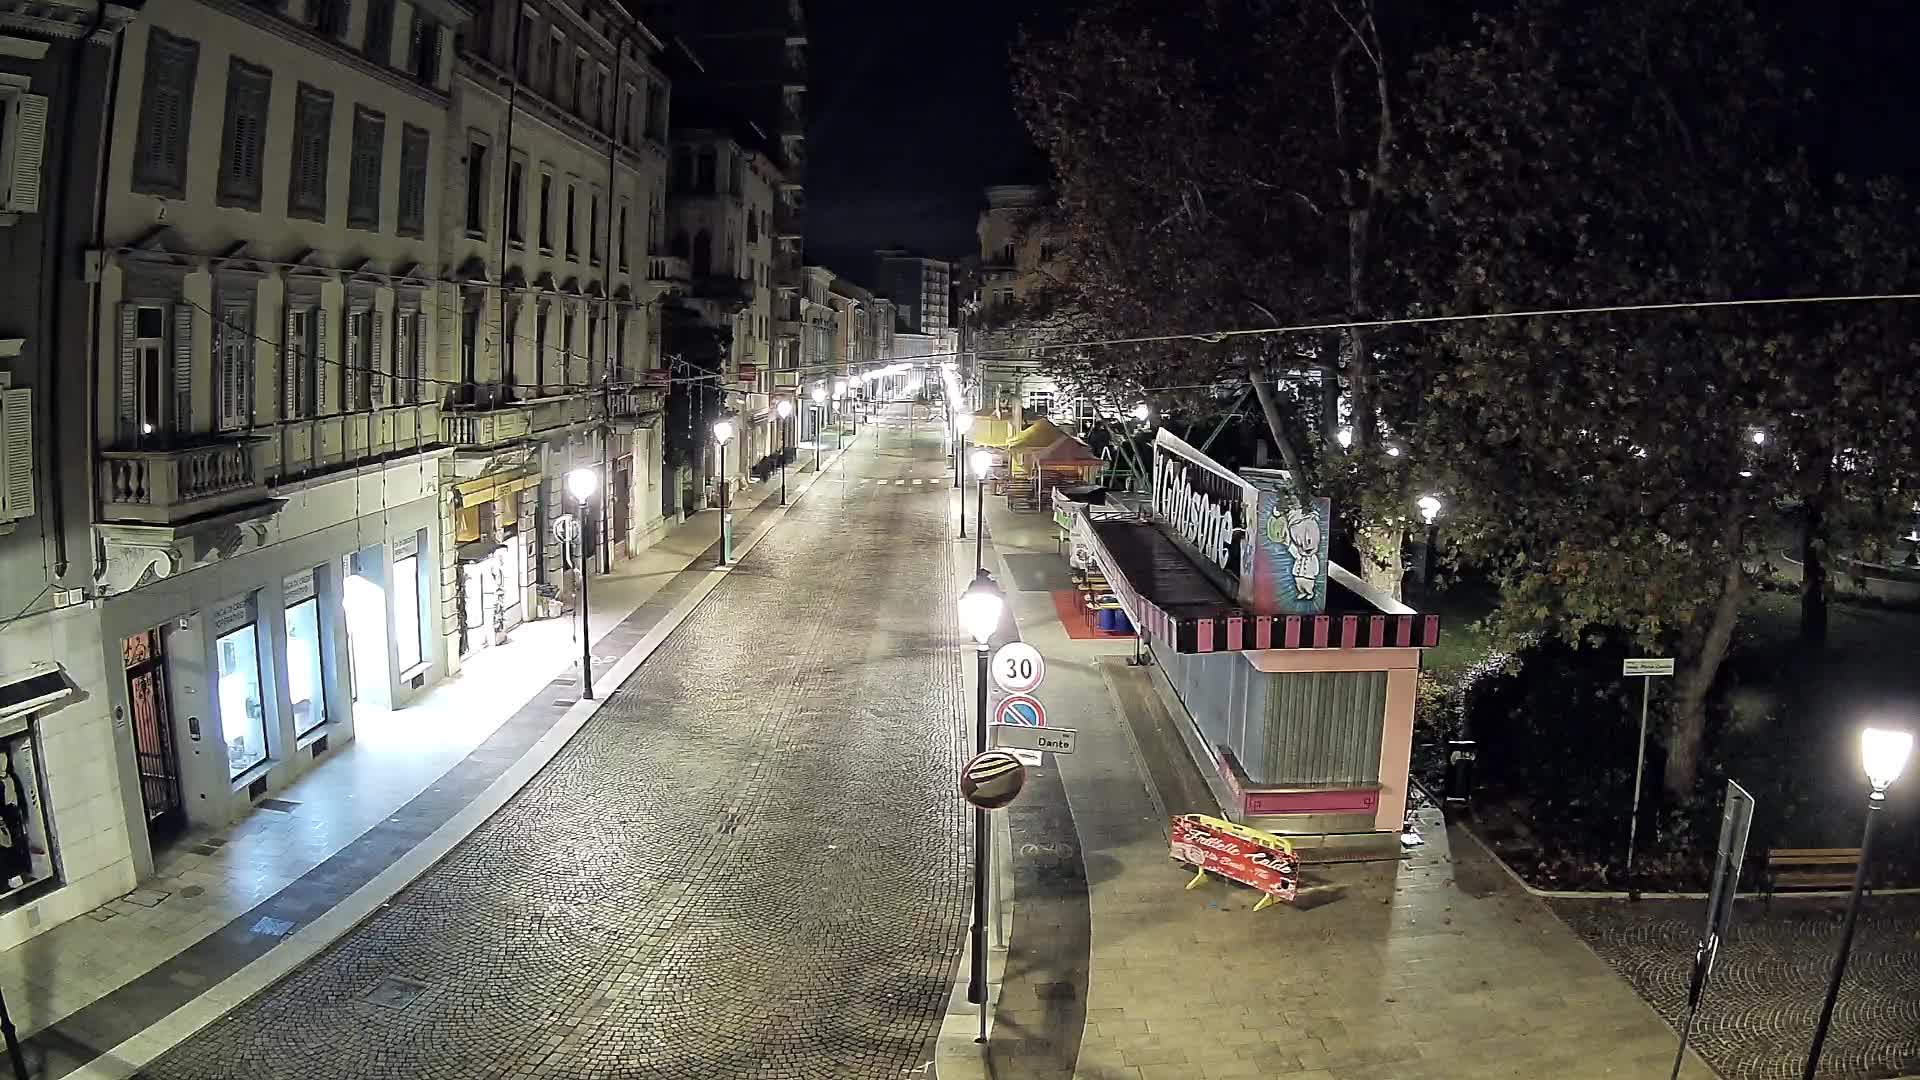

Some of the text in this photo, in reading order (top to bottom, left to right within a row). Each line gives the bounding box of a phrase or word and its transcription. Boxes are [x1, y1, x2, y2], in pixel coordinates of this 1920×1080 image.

[1163, 458, 1232, 571] Golosone
[1006, 658, 1032, 679] 30
[1038, 737, 1069, 749] Dante
